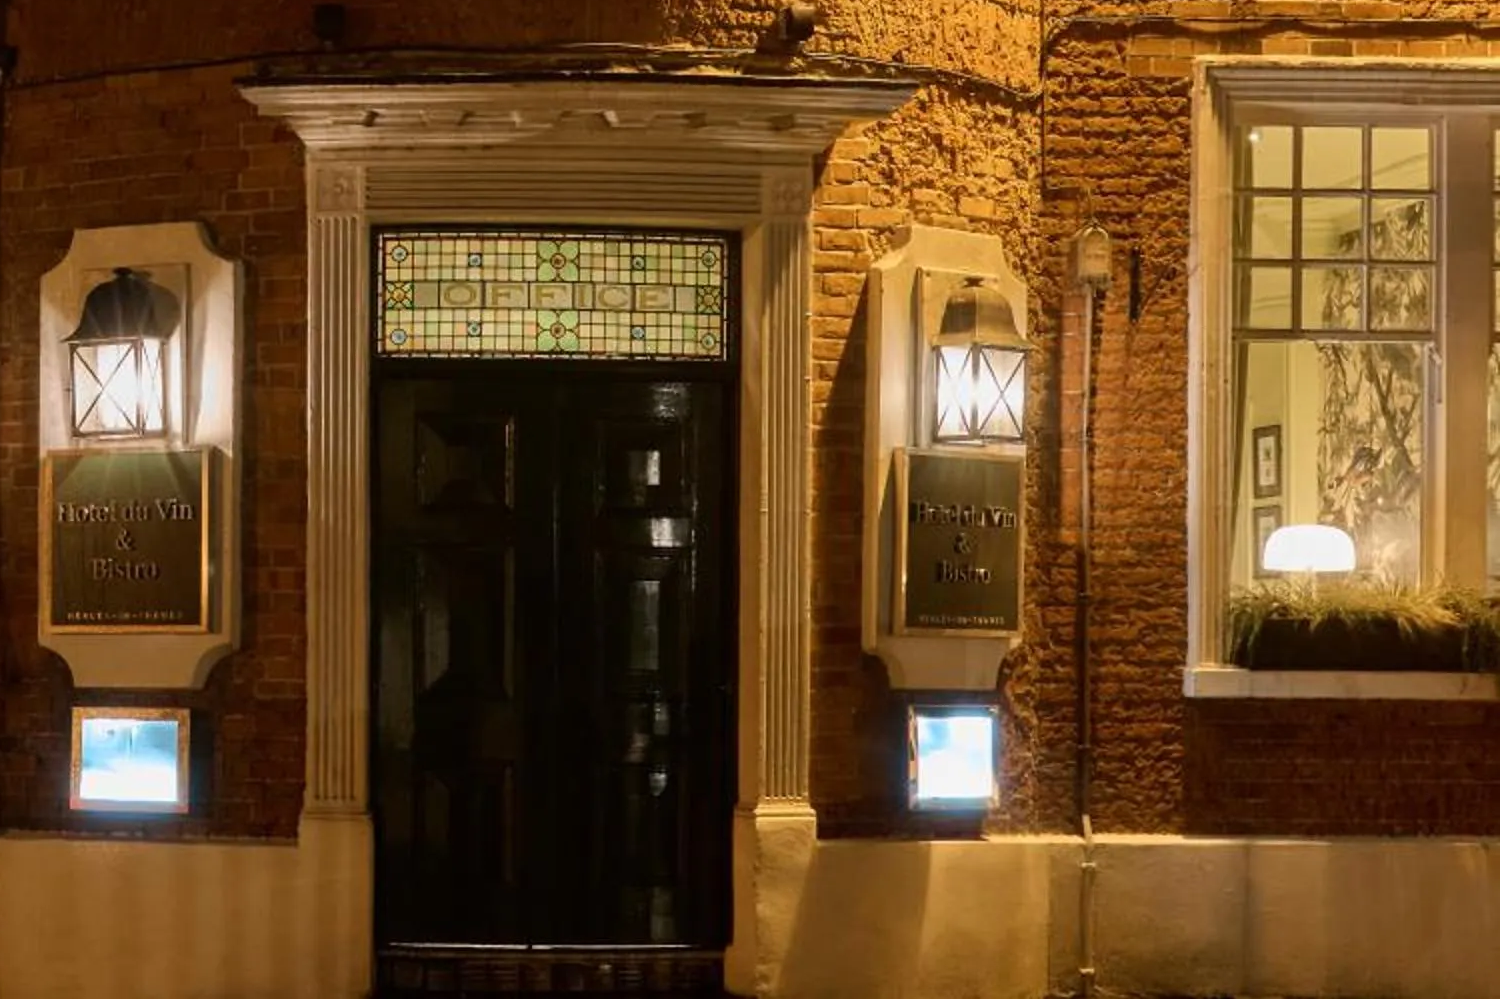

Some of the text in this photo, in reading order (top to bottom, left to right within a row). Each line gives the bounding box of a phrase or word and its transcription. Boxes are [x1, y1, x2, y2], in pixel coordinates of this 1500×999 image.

[442, 285, 671, 310] OFFICE
[57, 497, 195, 522] Hotel du Vin
[114, 528, 135, 551] &
[89, 556, 160, 581] Bistro
[941, 559, 992, 585] Bistro
